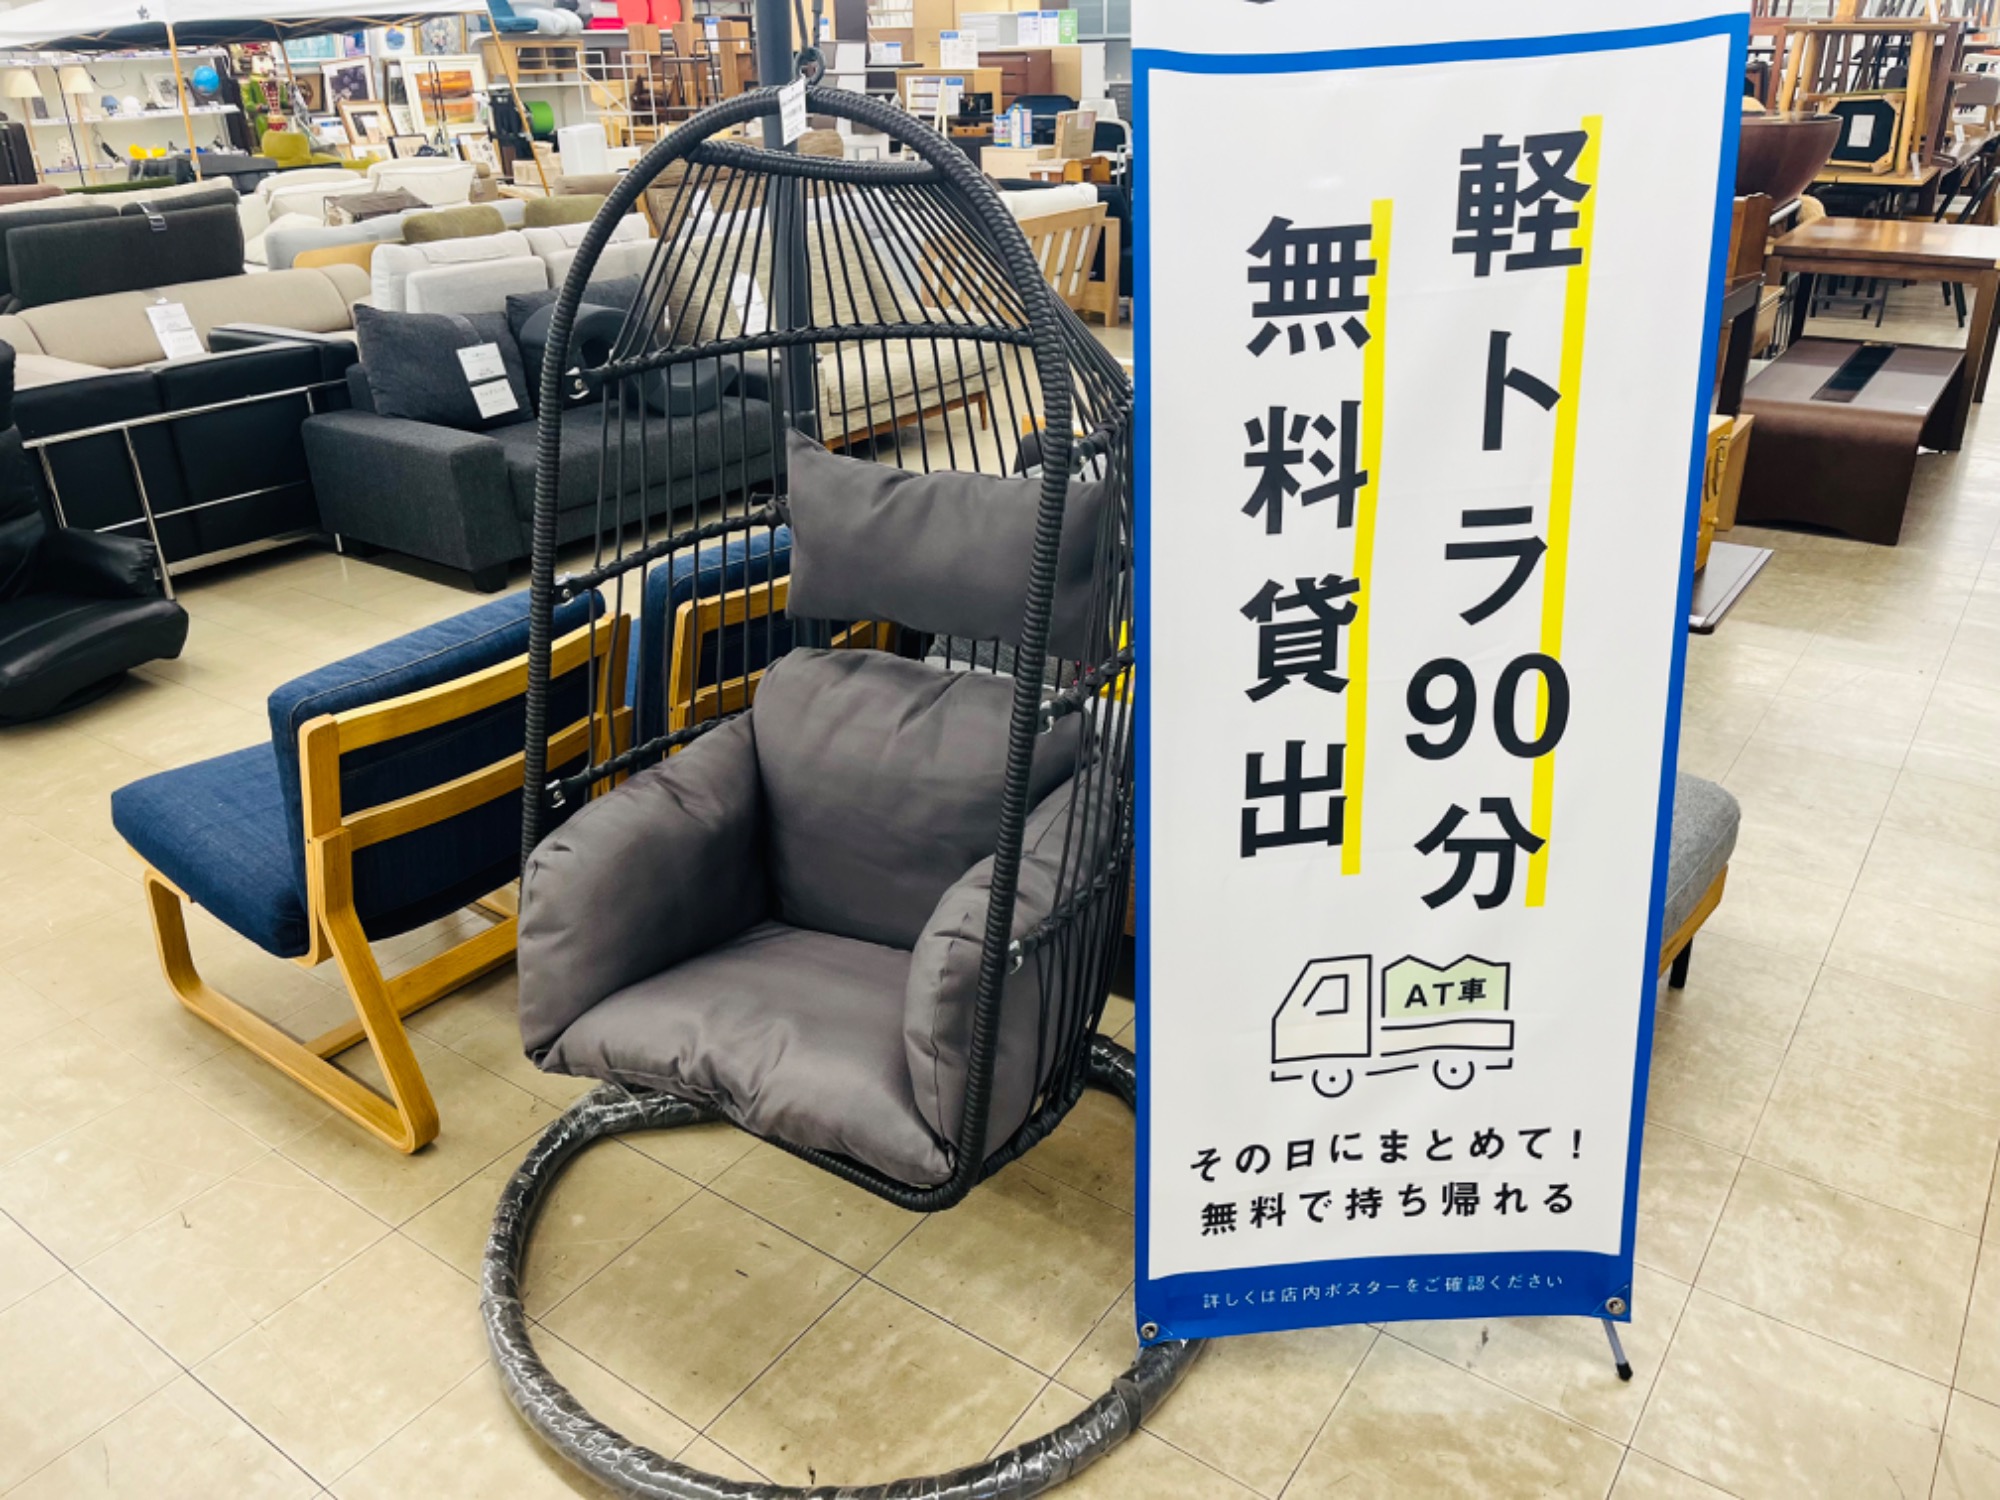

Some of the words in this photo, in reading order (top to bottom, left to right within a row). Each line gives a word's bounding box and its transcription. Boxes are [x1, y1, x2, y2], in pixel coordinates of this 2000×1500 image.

[1239, 217, 1377, 858] 無料貸出
[1405, 131, 1590, 909] 軽トラ90分
[1404, 977, 1487, 1009] AT車
[1201, 1181, 1574, 1236] 無料で持ち帰れる
[1202, 1273, 1563, 1309] 詳しくは店内ポスターをご確認ください
